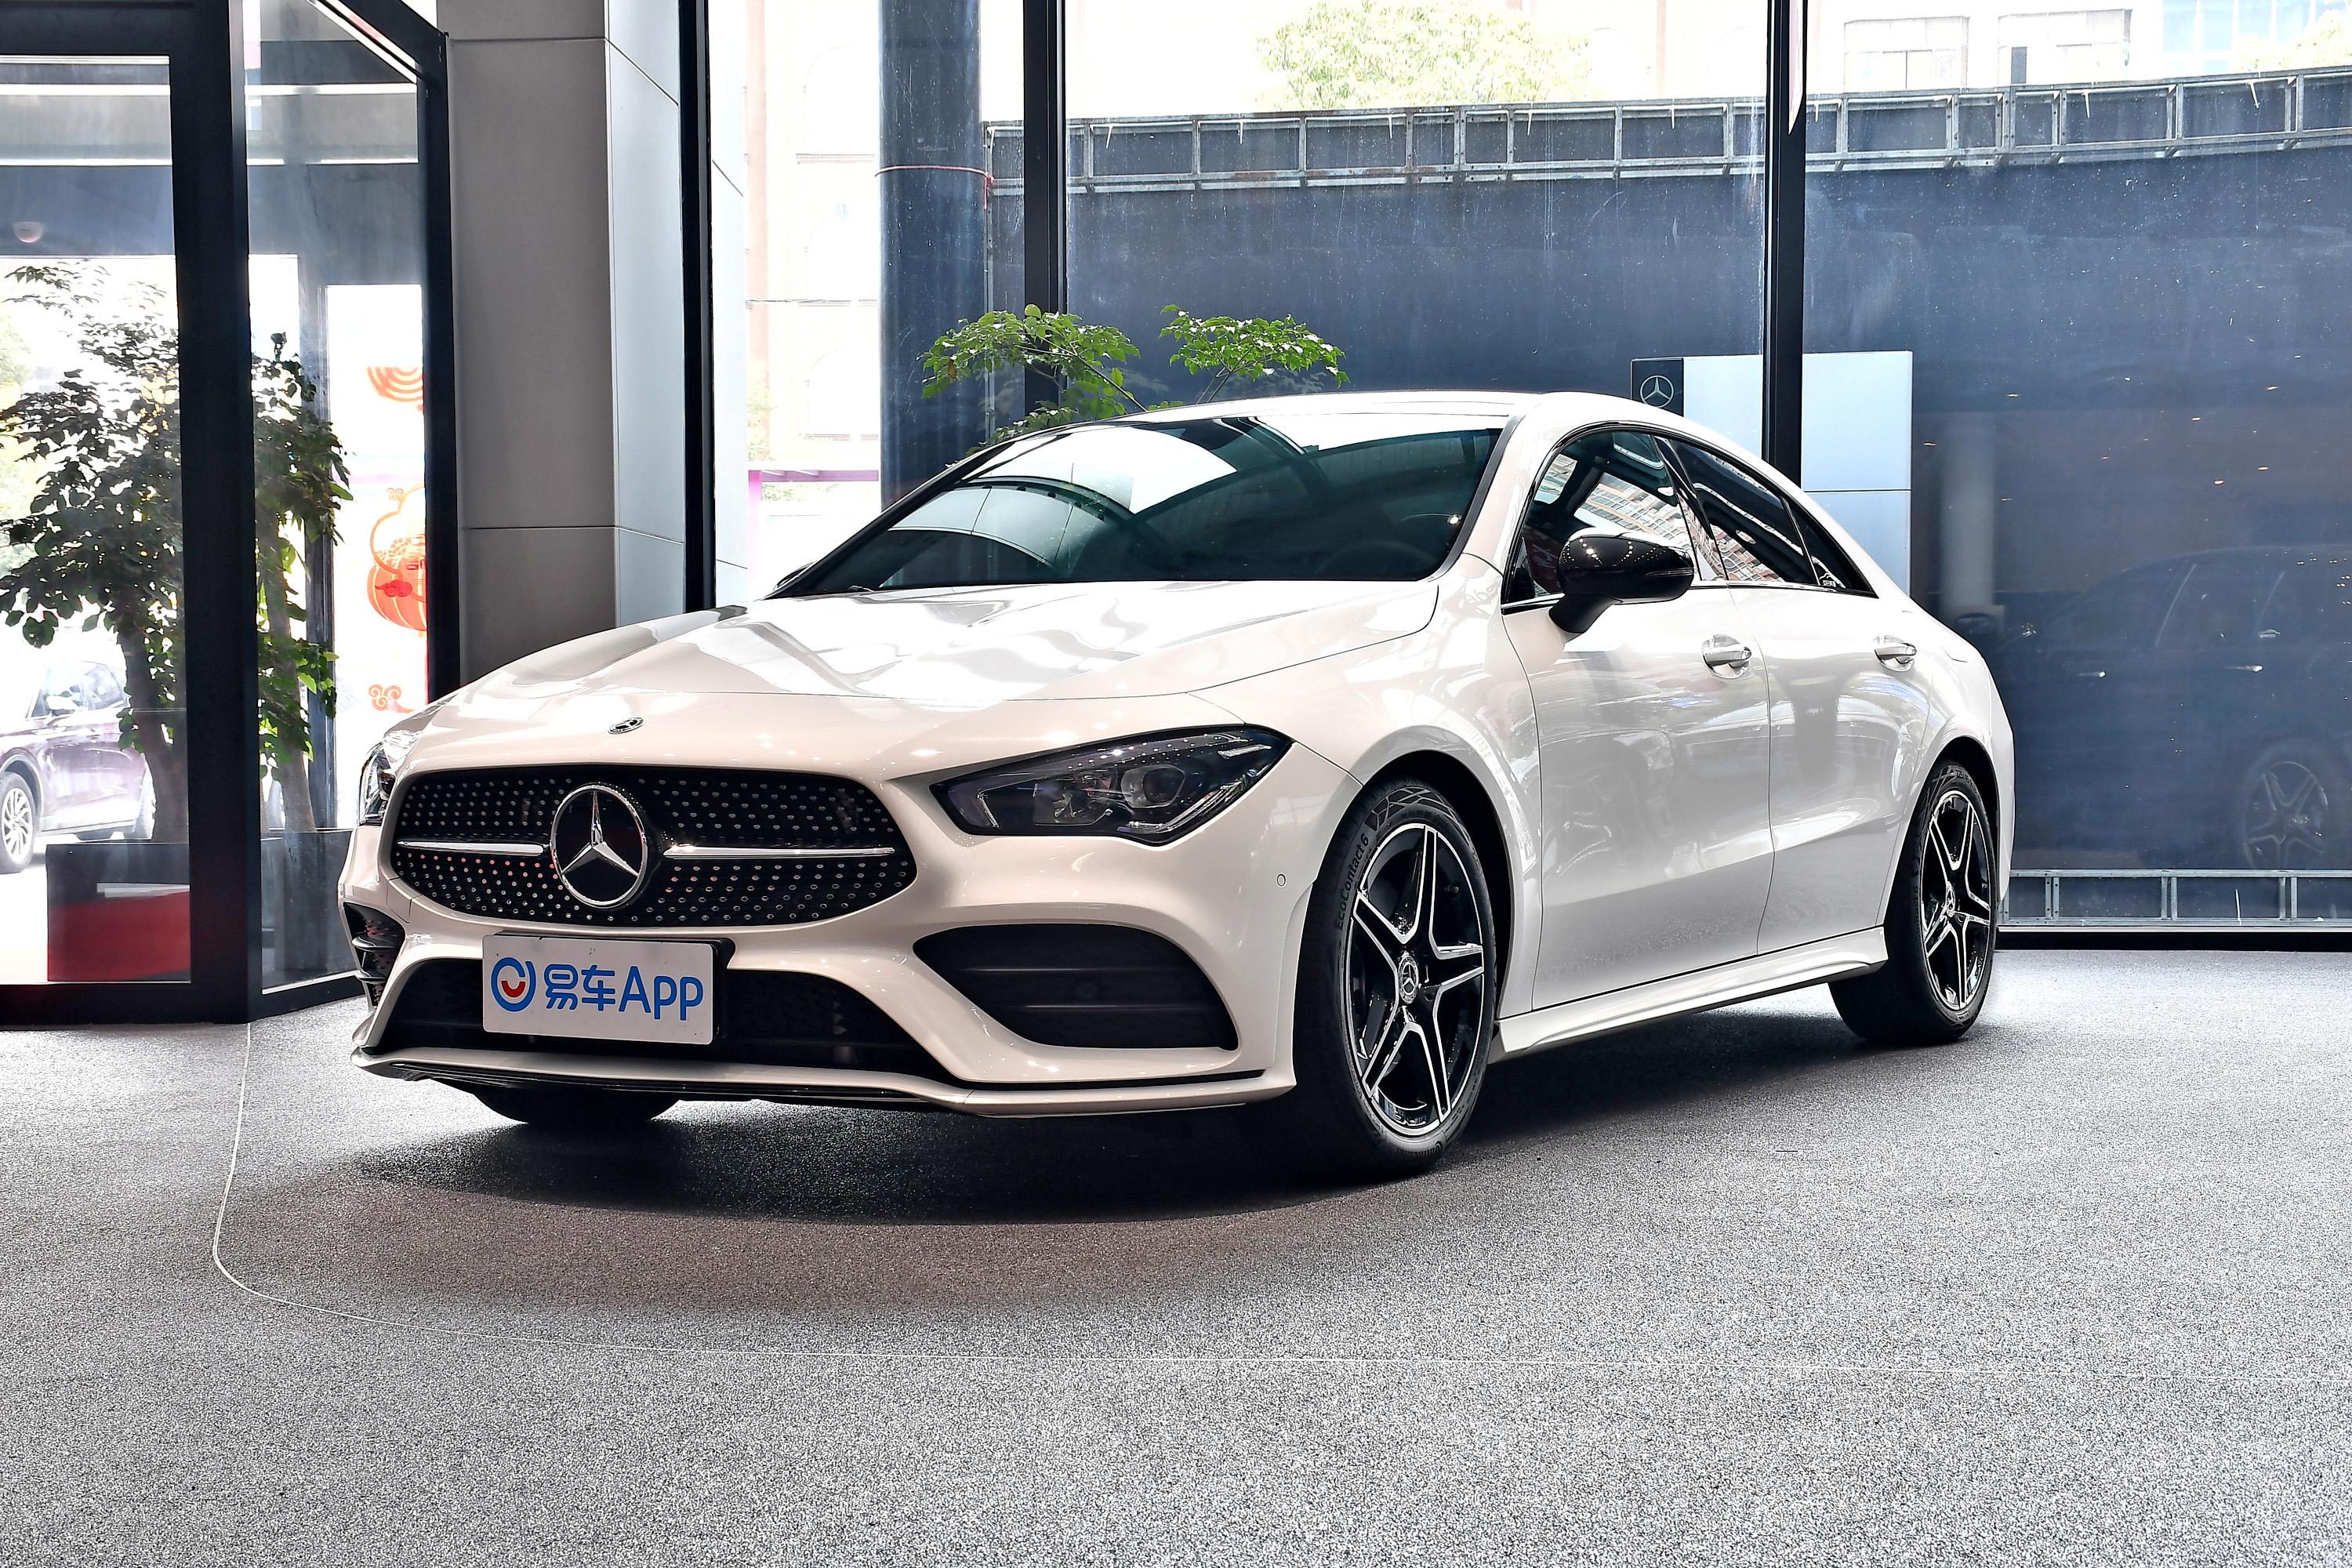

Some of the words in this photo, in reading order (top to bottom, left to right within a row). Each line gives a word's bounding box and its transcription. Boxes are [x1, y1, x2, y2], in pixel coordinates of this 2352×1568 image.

[1336, 844, 1365, 931] EcoContact
[1360, 833, 1369, 847] 6
[543, 964, 704, 1022] 易车App
